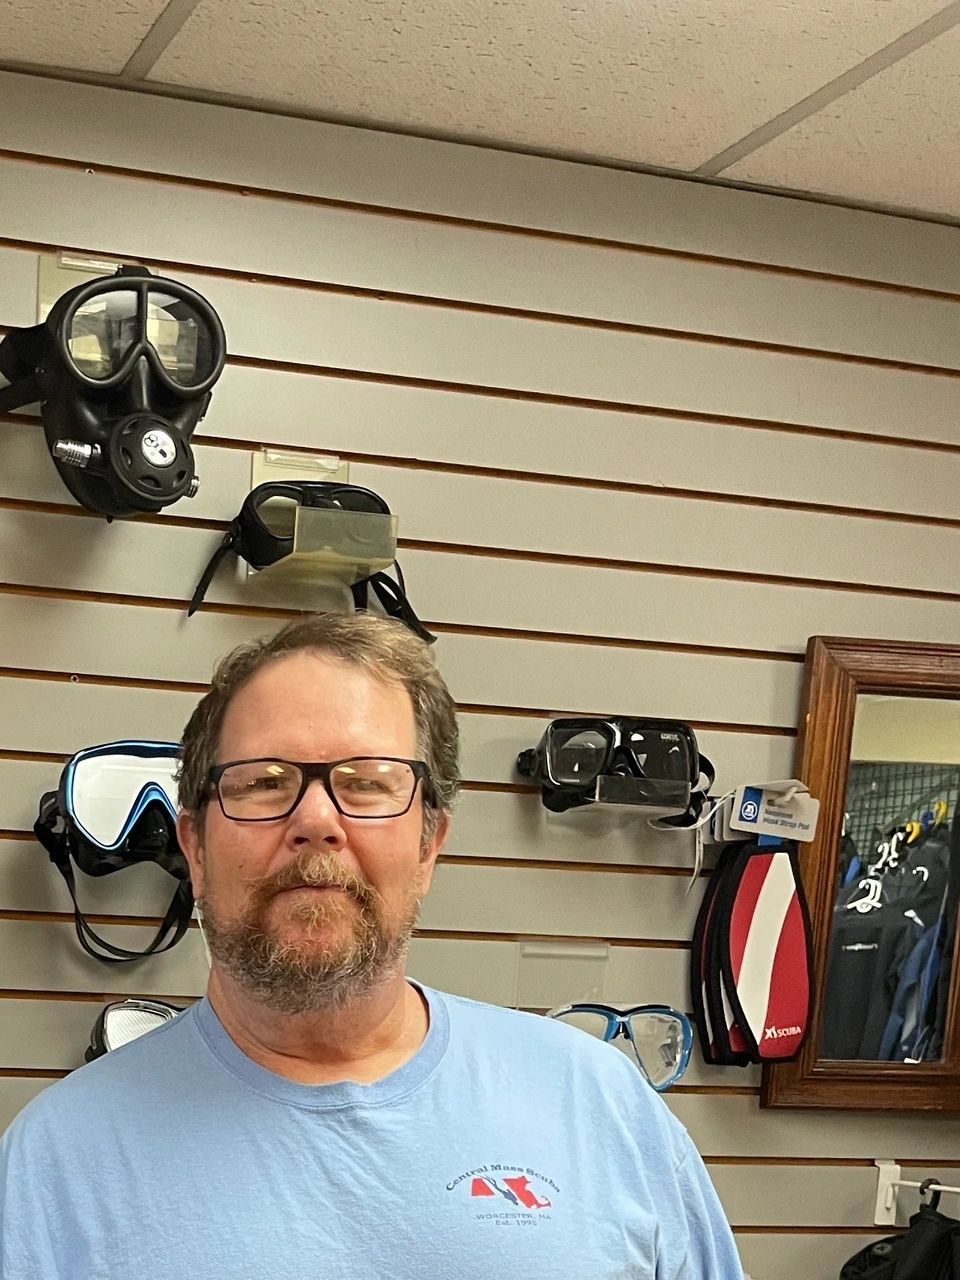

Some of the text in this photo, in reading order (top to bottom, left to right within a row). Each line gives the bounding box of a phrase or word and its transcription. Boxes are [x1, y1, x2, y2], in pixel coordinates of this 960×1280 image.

[777, 1026, 802, 1038] SCUBA
[446, 1164, 561, 1193] Central Mass Scuba
